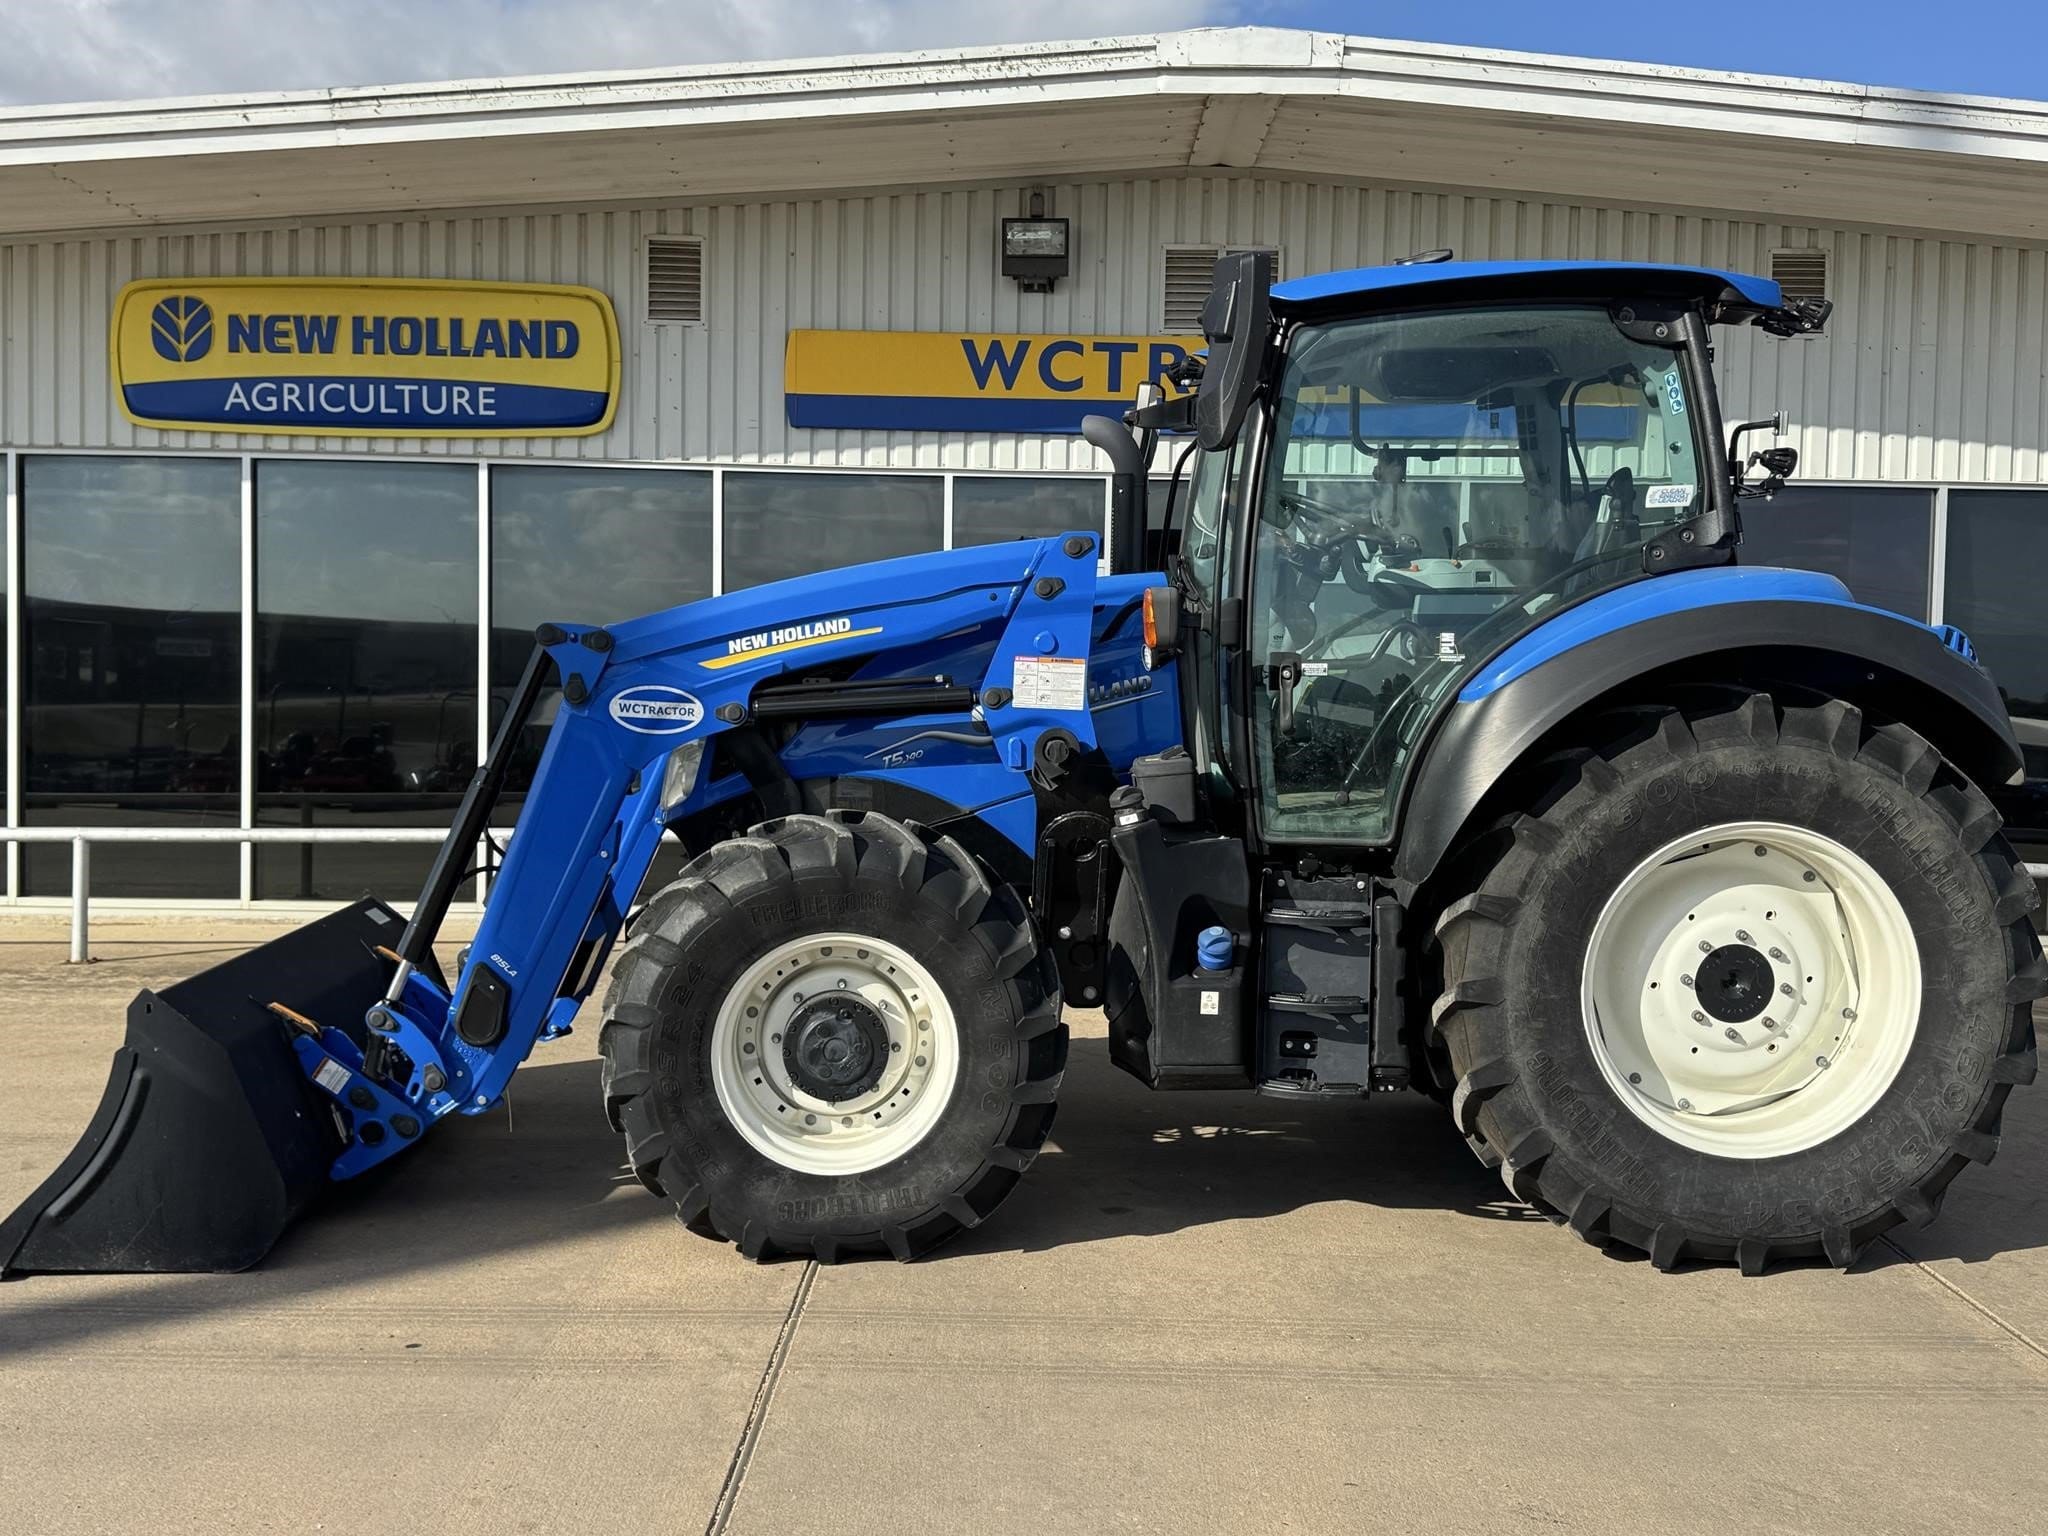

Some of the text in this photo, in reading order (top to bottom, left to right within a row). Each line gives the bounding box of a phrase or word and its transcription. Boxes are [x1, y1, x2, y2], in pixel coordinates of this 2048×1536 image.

[228, 314, 580, 359] NEW HOLLAND
[224, 382, 497, 416] AGRICULTURE
[728, 618, 851, 654] NEW HOLLAND
[618, 702, 695, 717] WCTRACTOR
[1857, 775, 1992, 936] TRELLEBORG
[750, 892, 895, 926] TRELLEBORG
[1525, 1050, 1662, 1201] TRELLEBORG
[777, 1183, 929, 1222] TRELLEBORG
